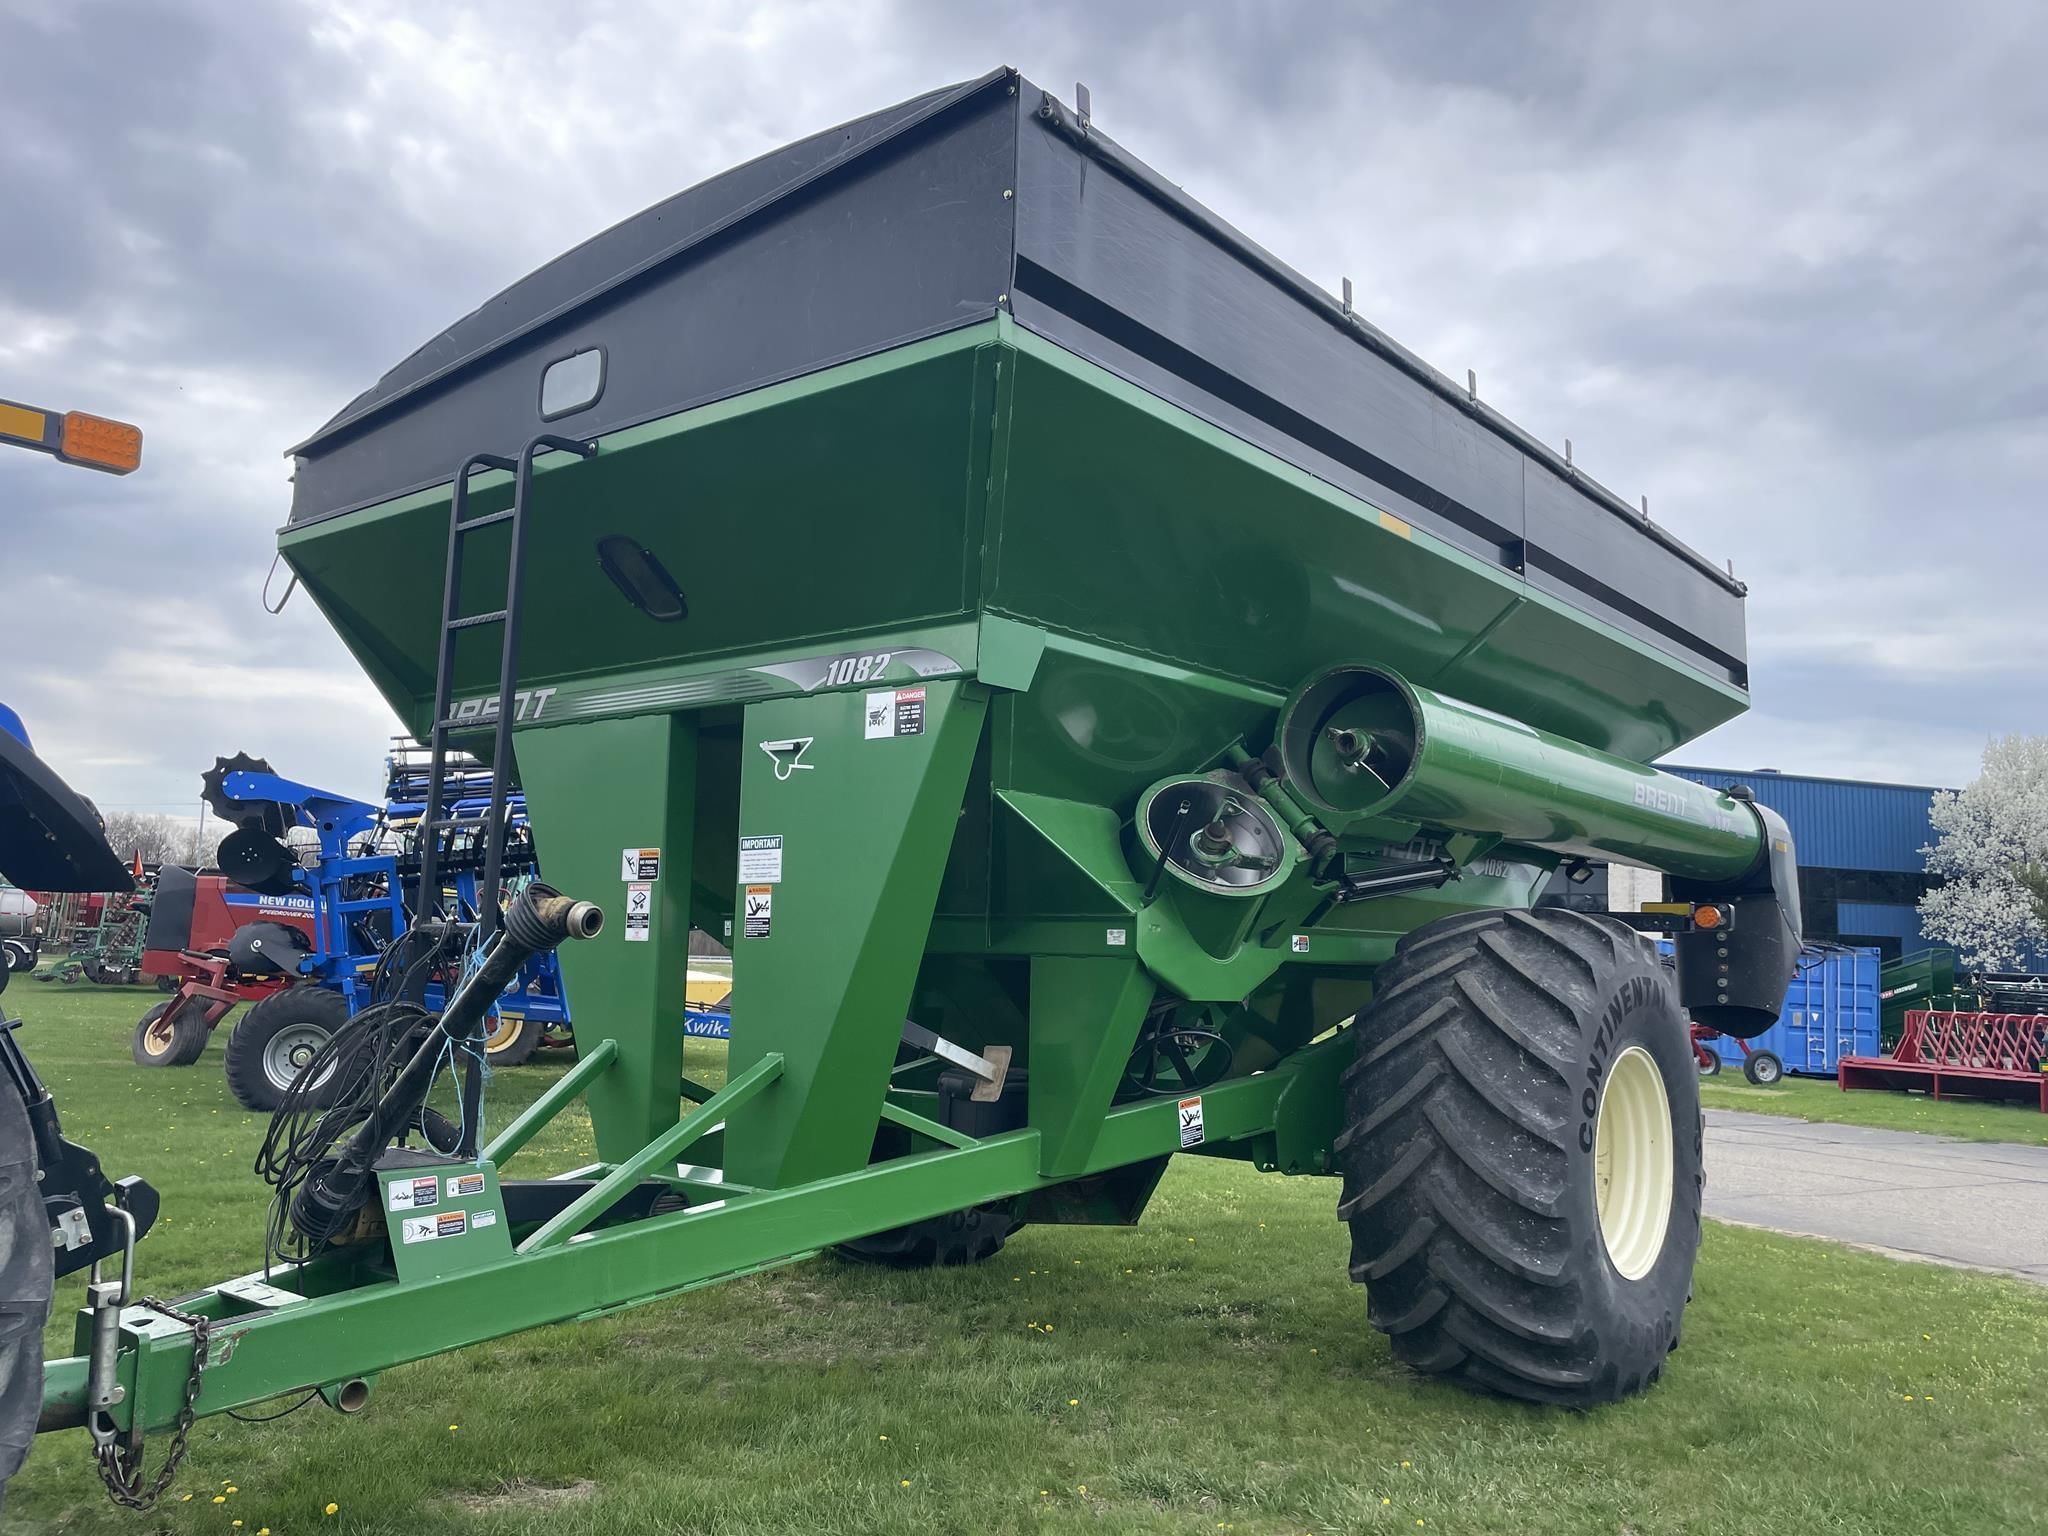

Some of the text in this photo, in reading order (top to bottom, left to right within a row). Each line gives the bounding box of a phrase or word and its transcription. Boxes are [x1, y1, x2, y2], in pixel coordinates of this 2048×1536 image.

[826, 653, 891, 686] 1082
[902, 691, 926, 700] DANGER
[1634, 782, 1687, 817] BRENT
[742, 838, 780, 849] IMPORTANT
[1484, 859, 1510, 879] 1082
[259, 895, 286, 906] NEW
[1579, 976, 1666, 1154] CONTINENTAL
